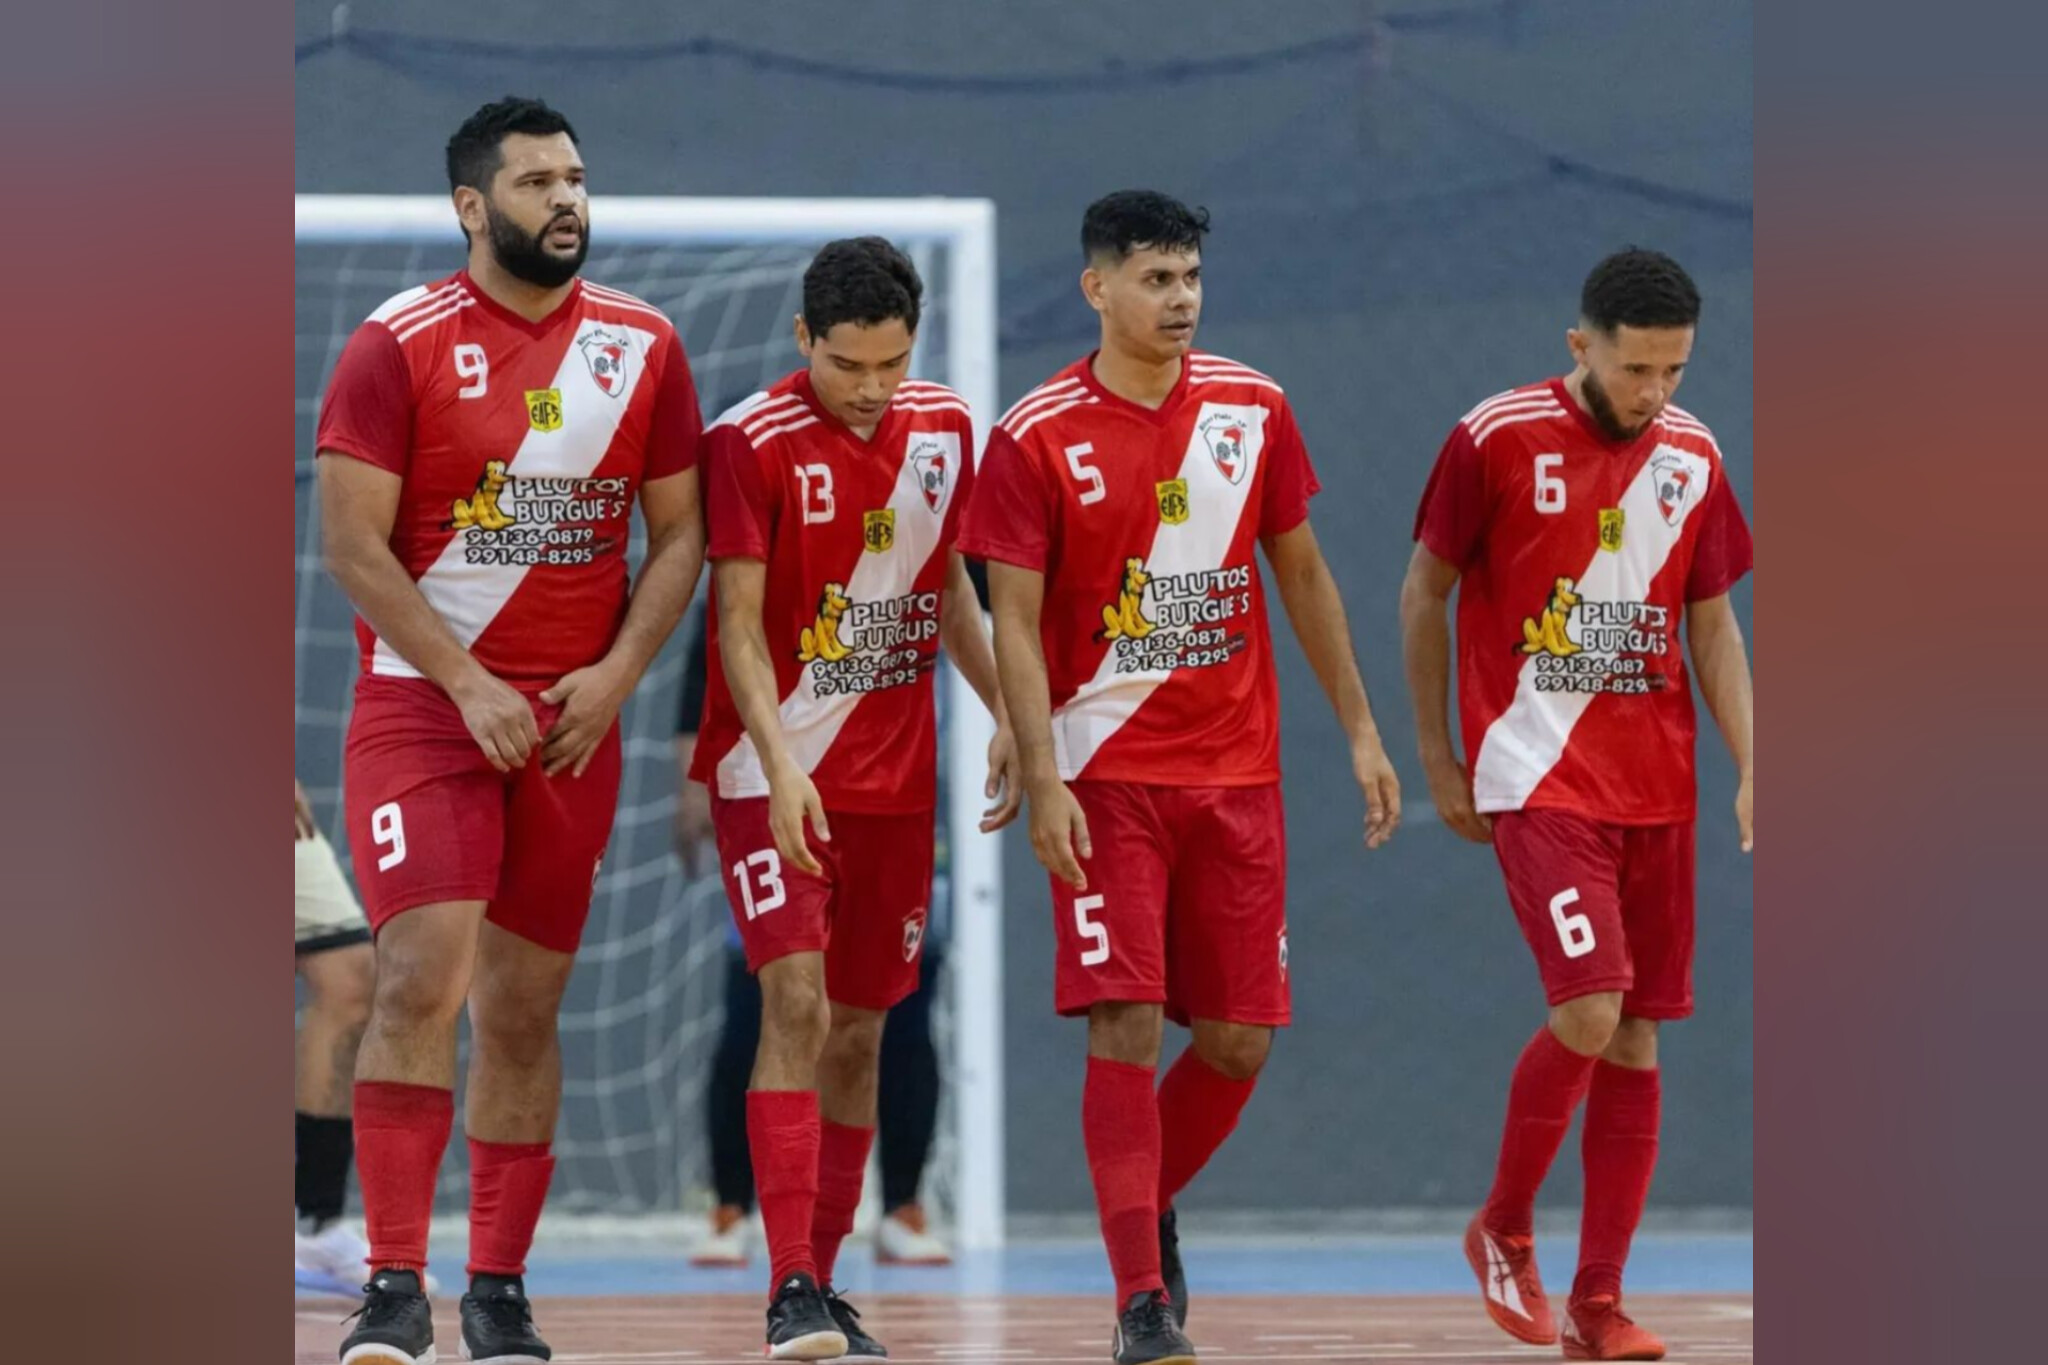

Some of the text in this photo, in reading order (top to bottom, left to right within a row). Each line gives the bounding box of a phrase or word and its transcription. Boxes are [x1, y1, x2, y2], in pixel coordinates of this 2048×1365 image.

[454, 343, 489, 399] 9
[795, 463, 835, 526] 13
[1064, 441, 1106, 506] 5
[1534, 453, 1567, 514] 6
[465, 528, 595, 548] 99136-0879
[514, 498, 626, 524] BURGUE'S
[465, 547, 594, 566] 99148-8295
[1152, 565, 1249, 602] PLUTOS
[1155, 591, 1249, 630] BURGUE'S
[372, 802, 407, 873] 9
[733, 848, 787, 922] 13
[1074, 894, 1110, 966] 5
[1549, 886, 1597, 959] 6
